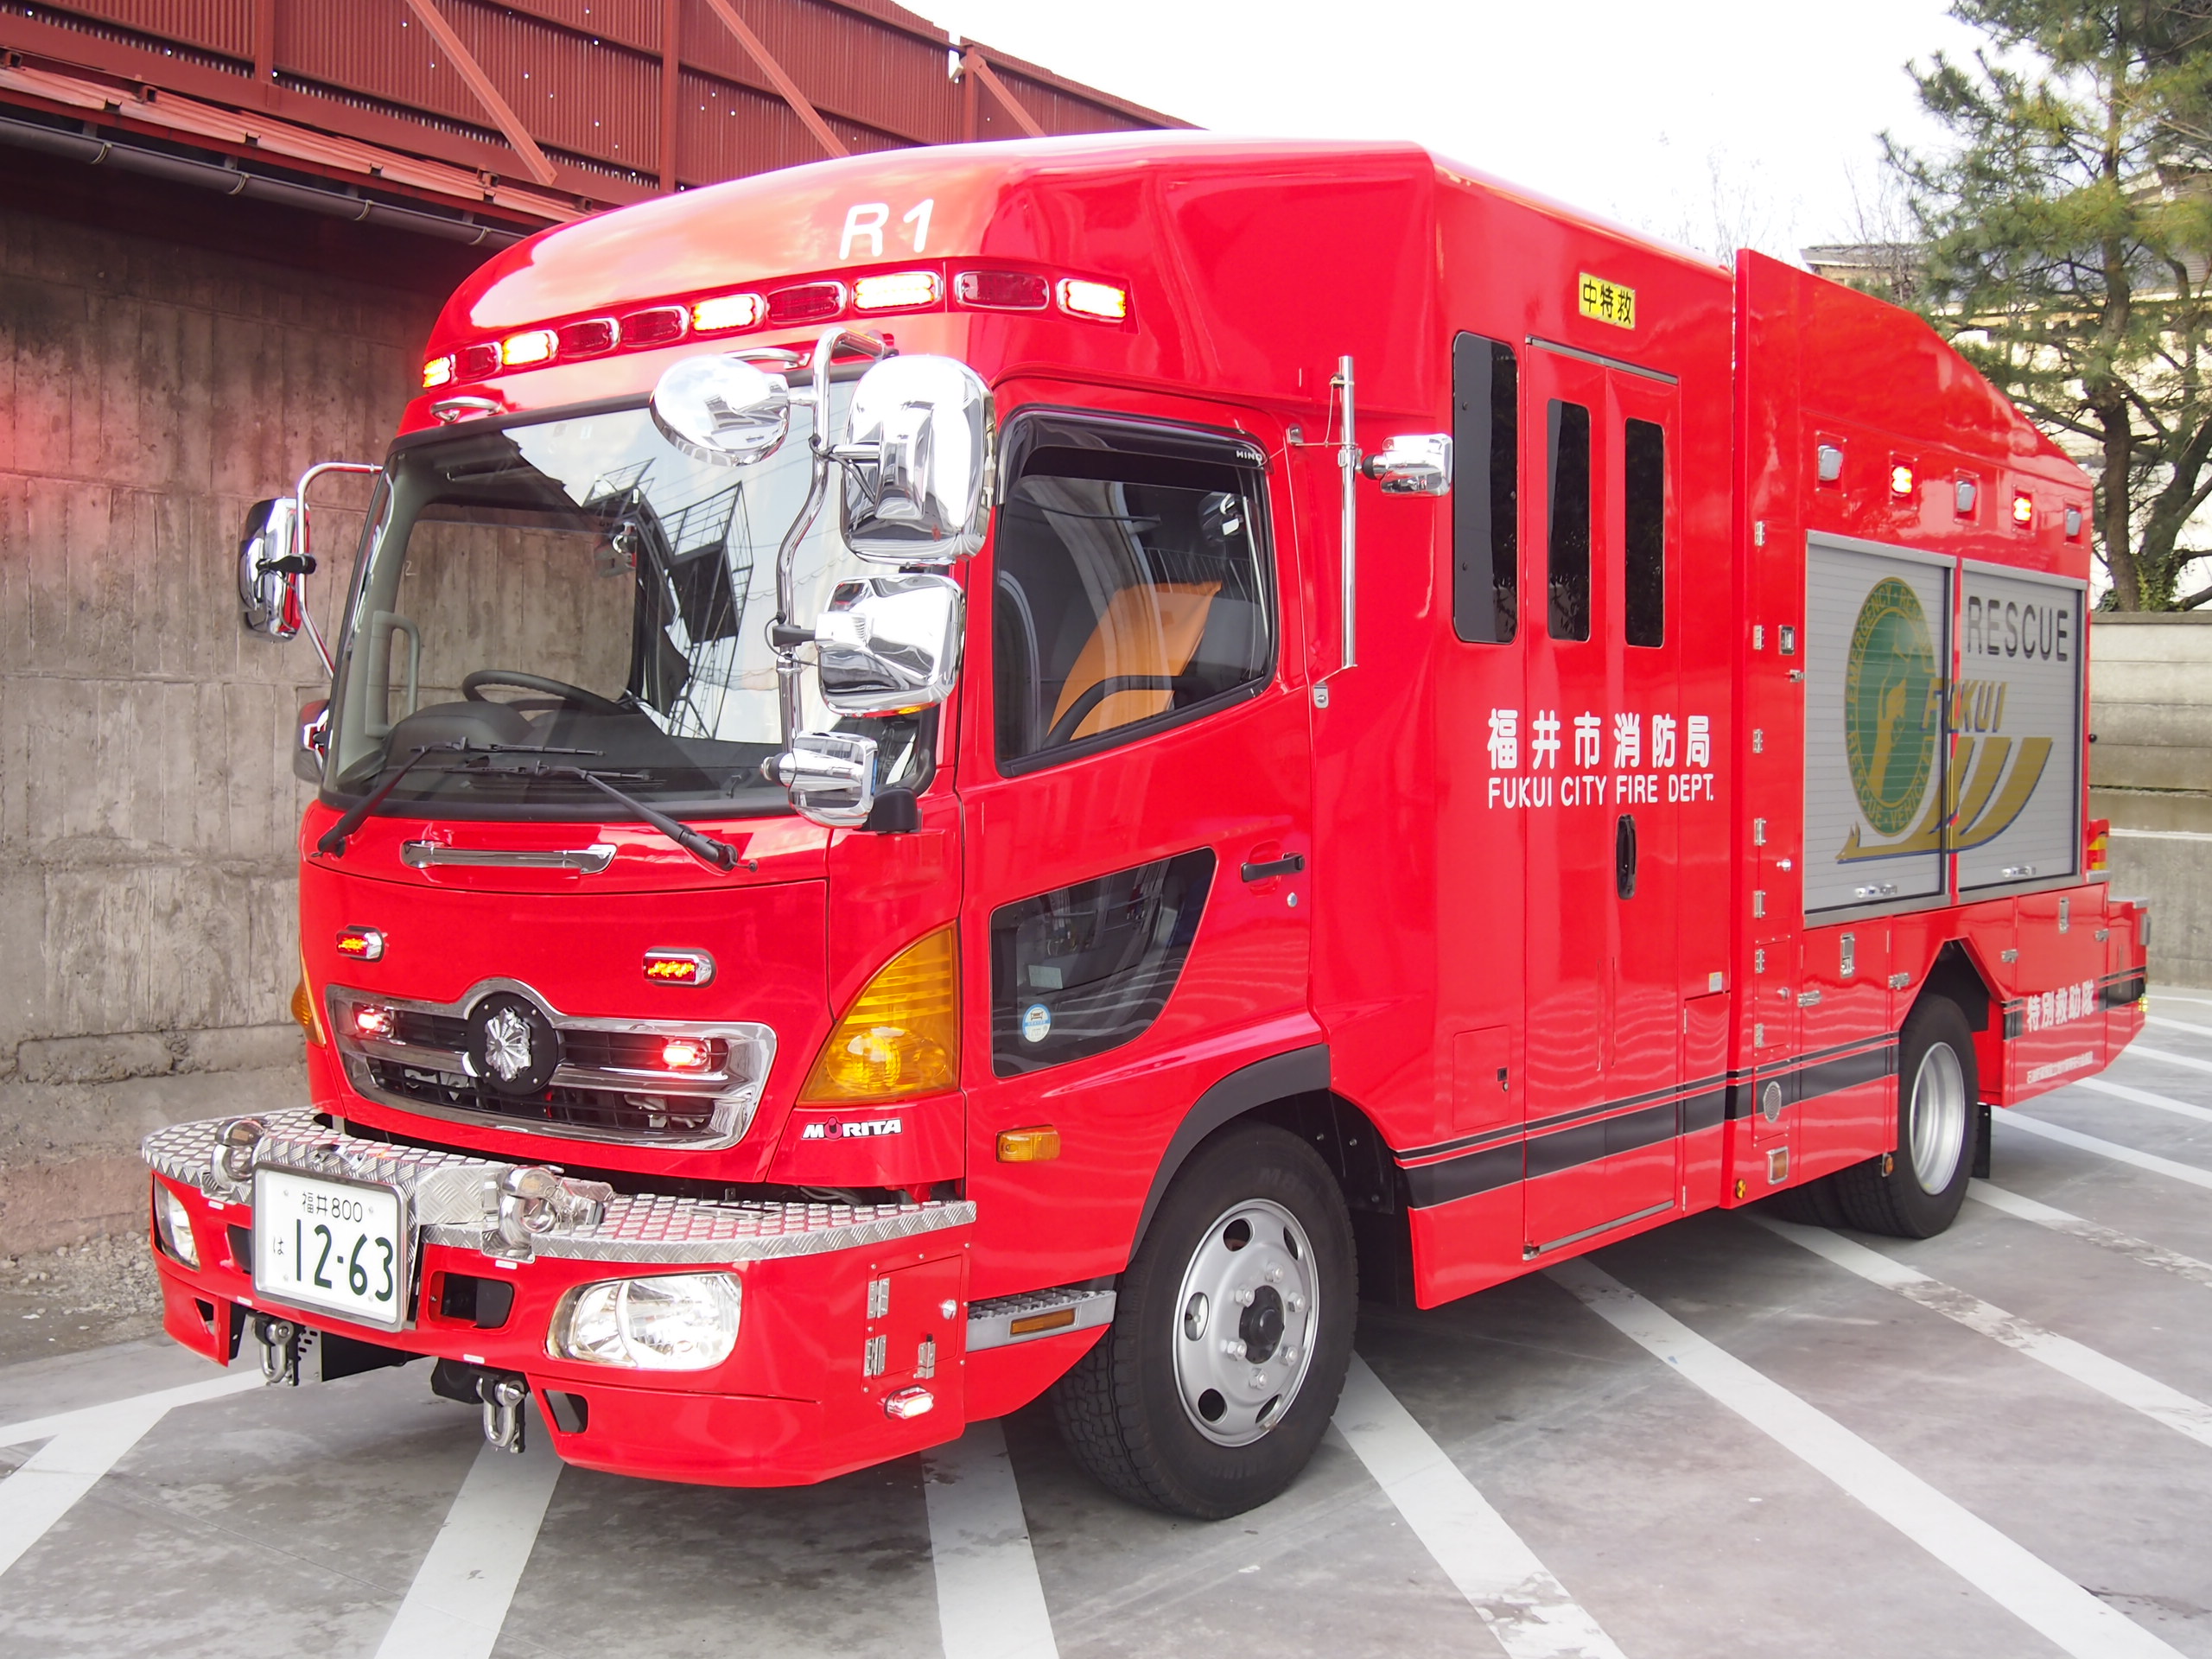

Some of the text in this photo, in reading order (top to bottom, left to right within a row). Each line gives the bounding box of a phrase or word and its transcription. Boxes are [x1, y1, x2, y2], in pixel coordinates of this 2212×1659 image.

[838, 198, 934, 261] R1
[1583, 279, 1631, 324] 中特救
[1236, 450, 1262, 461] HINO
[1846, 584, 1893, 703] EMERGENCY
[1967, 595, 2068, 662] RESCUE
[1487, 708, 1710, 771] 福井市消防局
[1488, 773, 1713, 809] FUKUI CITY FIRE DEPT.
[2027, 980, 2094, 1033] 特別救助隊
[802, 1116, 902, 1139] MORITA
[273, 1237, 284, 1255] は
